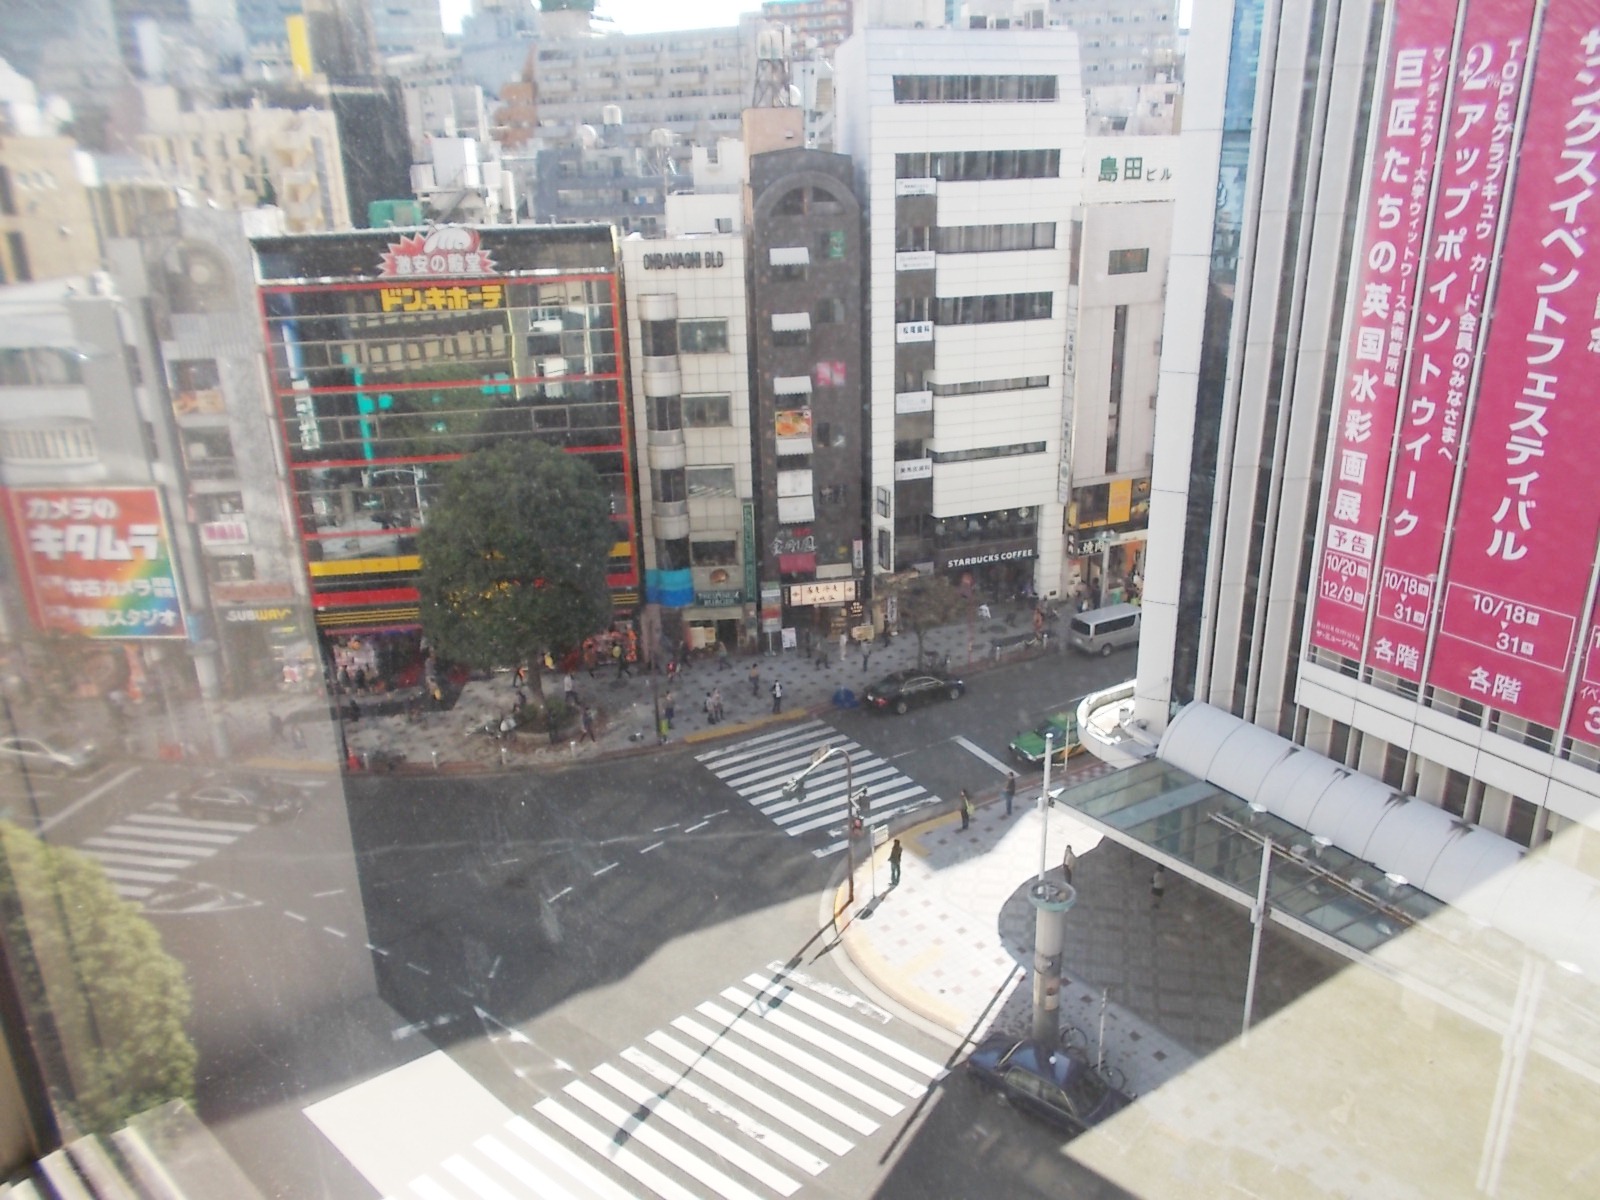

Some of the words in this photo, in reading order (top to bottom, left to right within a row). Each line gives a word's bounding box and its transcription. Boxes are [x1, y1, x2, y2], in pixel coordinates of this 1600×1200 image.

[26, 497, 118, 520] カメラの
[29, 523, 160, 561] キタムラ
[1333, 528, 1368, 555] 予告
[947, 553, 999, 568] STARBUCKS
[1000, 548, 1033, 560] COFFEE
[226, 608, 292, 622] SUBWAY
[1373, 637, 1420, 672] 各階
[1468, 666, 1522, 705] 各階
